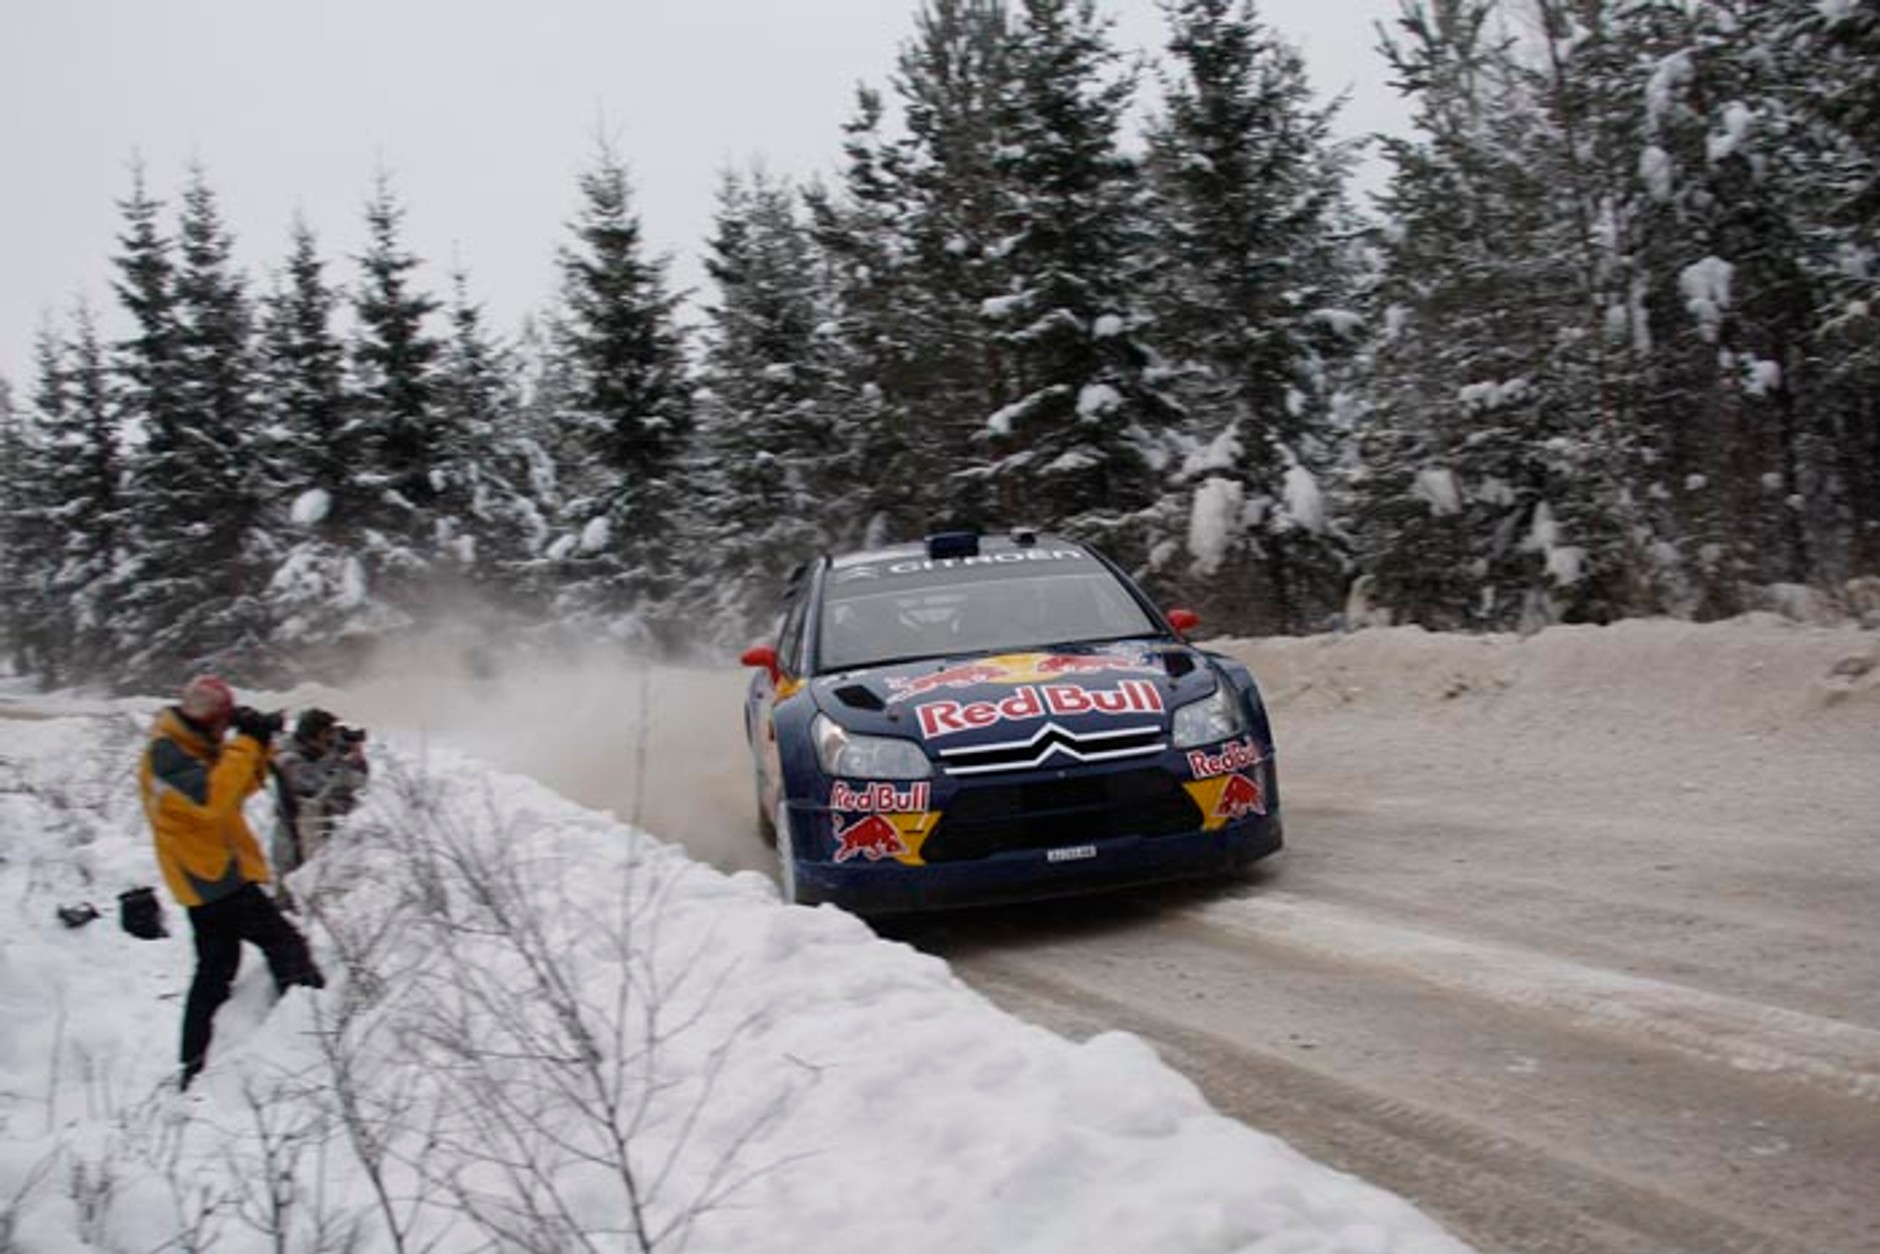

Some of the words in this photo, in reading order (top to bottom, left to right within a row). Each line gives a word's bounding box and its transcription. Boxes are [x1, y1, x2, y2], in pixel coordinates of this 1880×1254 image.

[915, 686, 1045, 739] Red
[1041, 679, 1165, 715] Bull
[1186, 743, 1239, 779] Red
[831, 781, 875, 812] Red
[876, 781, 930, 812] Bull
